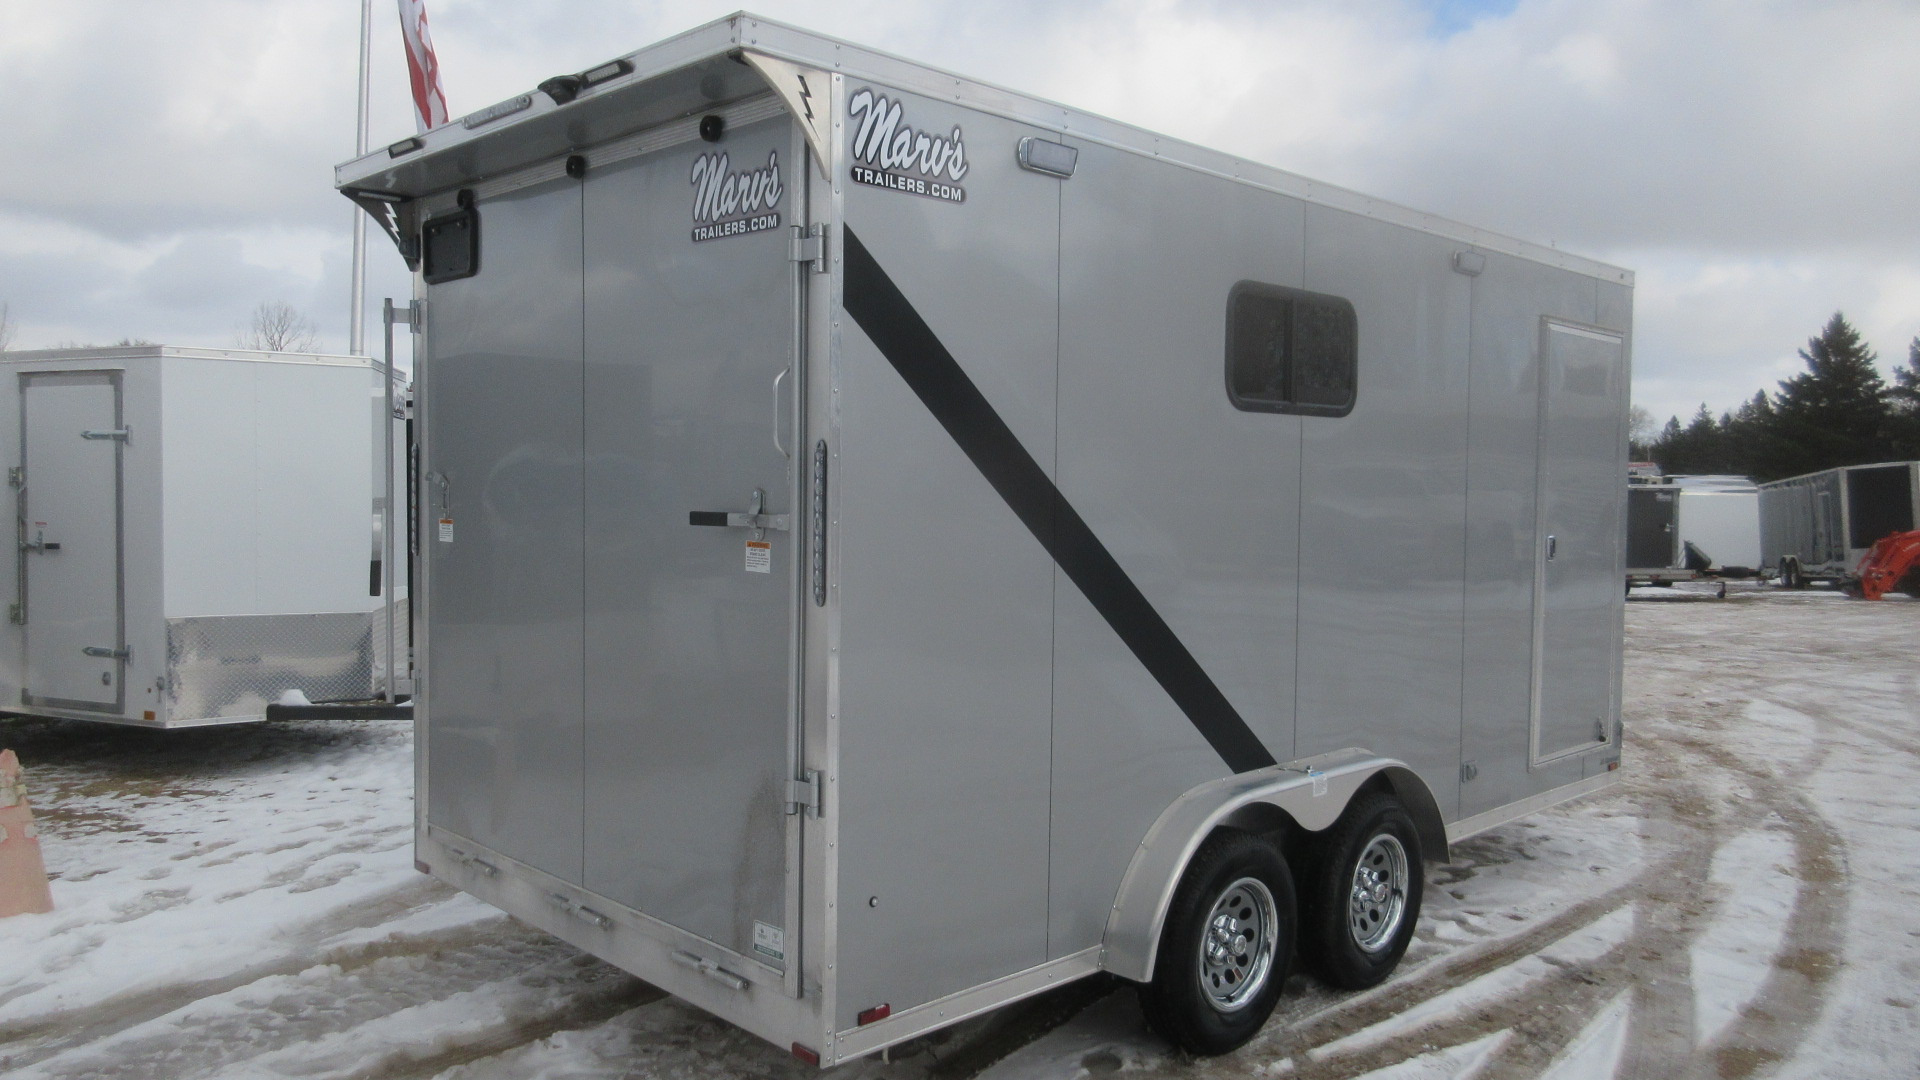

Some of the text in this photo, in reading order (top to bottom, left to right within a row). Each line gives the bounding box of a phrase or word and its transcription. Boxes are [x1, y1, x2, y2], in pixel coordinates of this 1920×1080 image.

[851, 90, 967, 181] Marv's
[692, 153, 782, 222] Marv's
[854, 167, 963, 202] TRAILERS.COM
[694, 215, 778, 242] TRAILERS.COM
